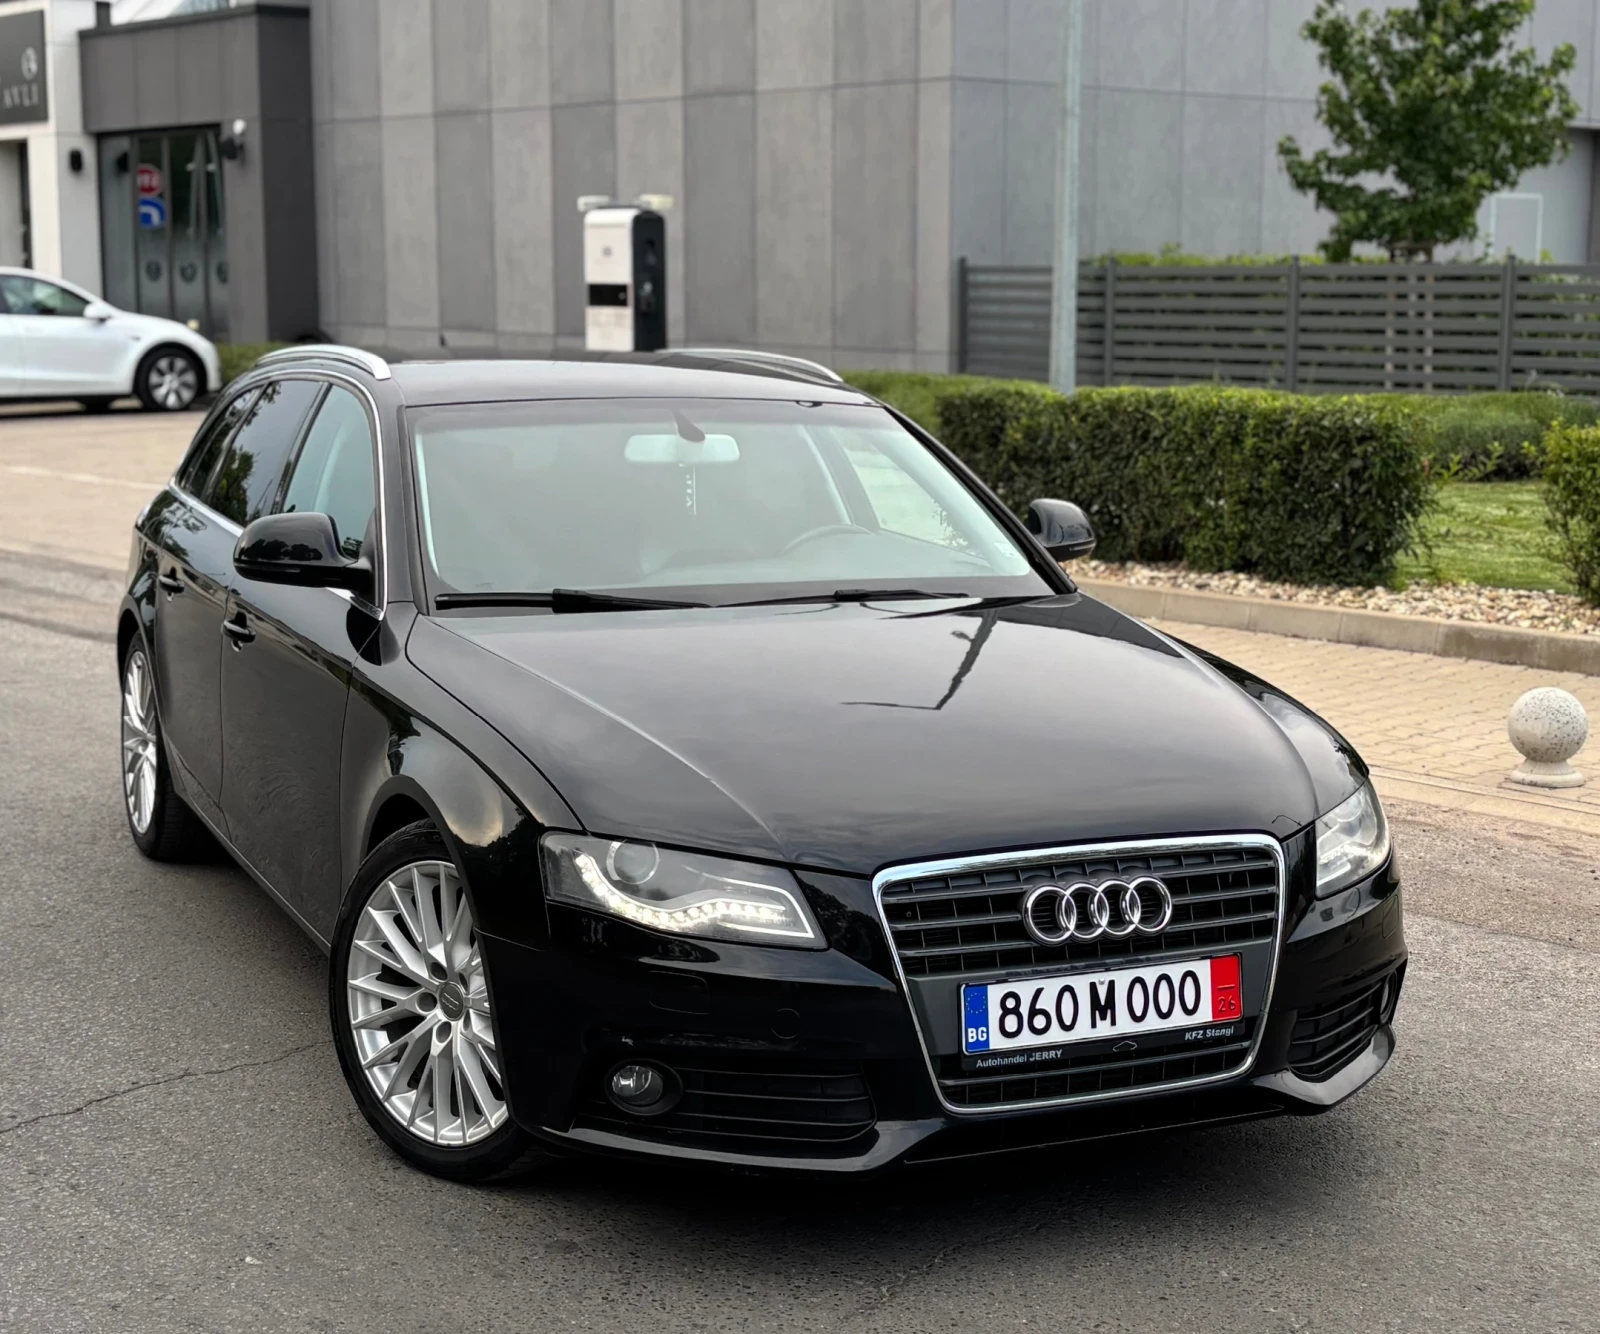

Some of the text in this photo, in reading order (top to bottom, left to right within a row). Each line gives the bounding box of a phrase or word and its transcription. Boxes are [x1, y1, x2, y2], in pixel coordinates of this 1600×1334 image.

[999, 970, 1201, 1038] 860 M 000
[1217, 995, 1237, 1013] 26
[967, 1026, 988, 1043] BG
[1185, 1025, 1235, 1041] KFZ Stangl
[976, 1049, 1063, 1068] Autohandel JERRY
